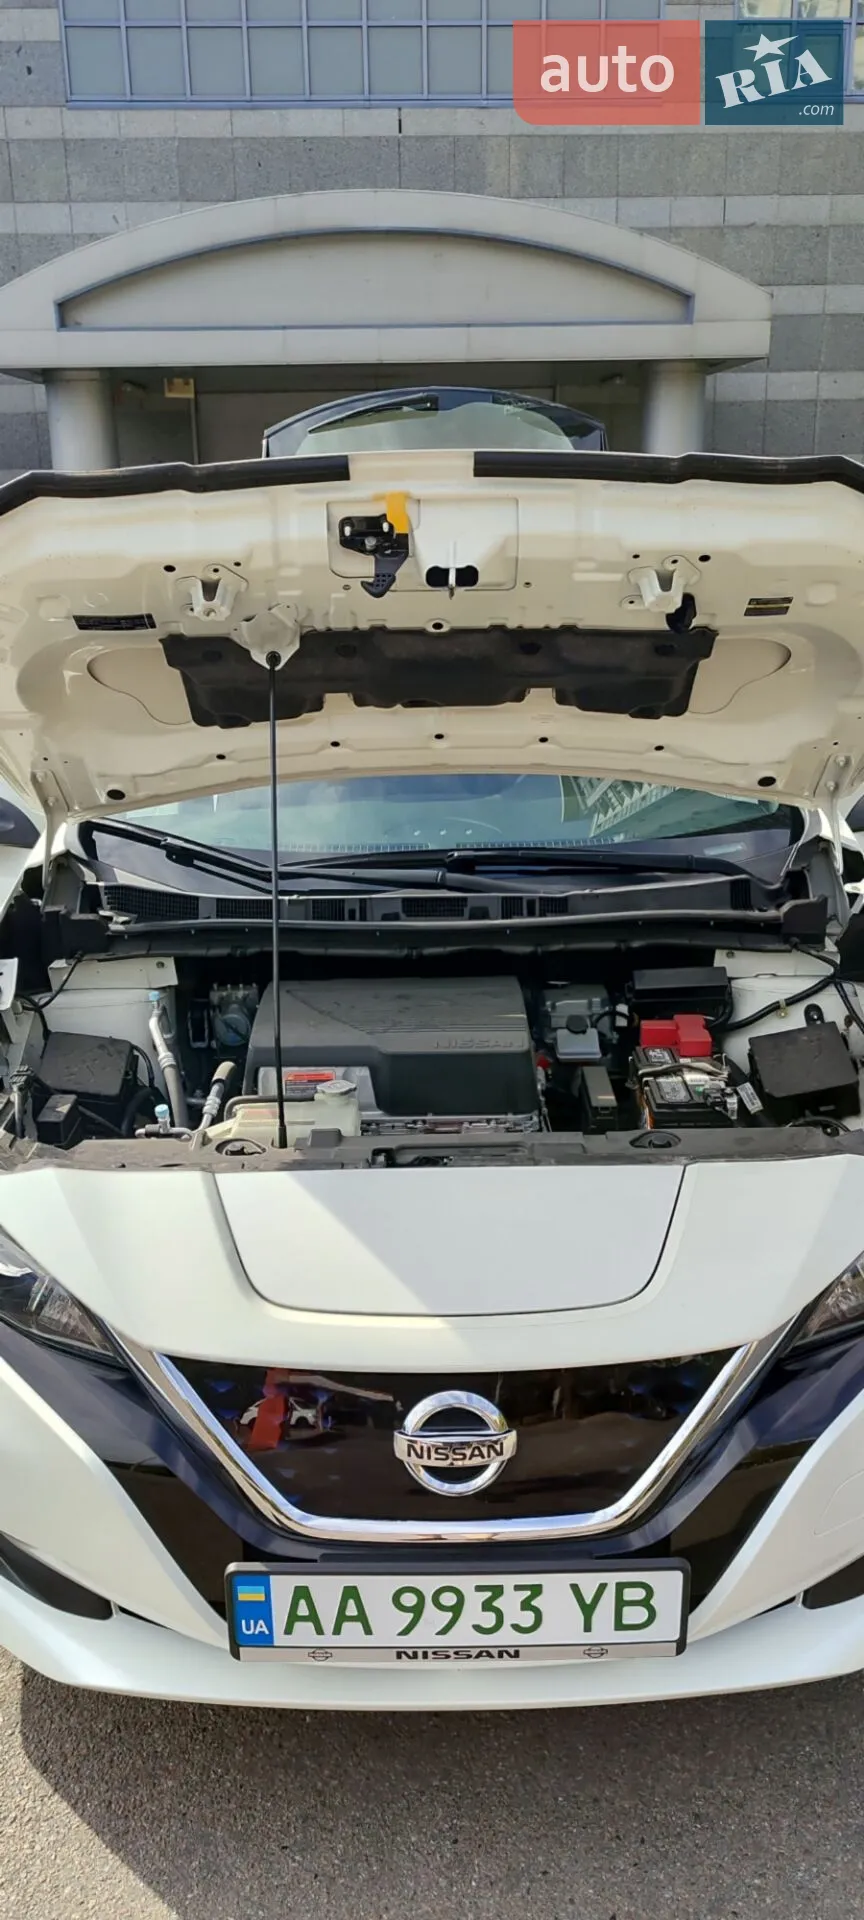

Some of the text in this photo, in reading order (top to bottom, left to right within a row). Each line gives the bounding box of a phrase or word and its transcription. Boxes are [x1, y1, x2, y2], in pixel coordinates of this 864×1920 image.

[433, 1036, 526, 1049] NISSAN
[406, 1441, 504, 1461] NISSAN
[283, 1580, 657, 1637] AA 9933 YB
[241, 1619, 270, 1635] UA
[395, 1649, 520, 1660] NISSAN
